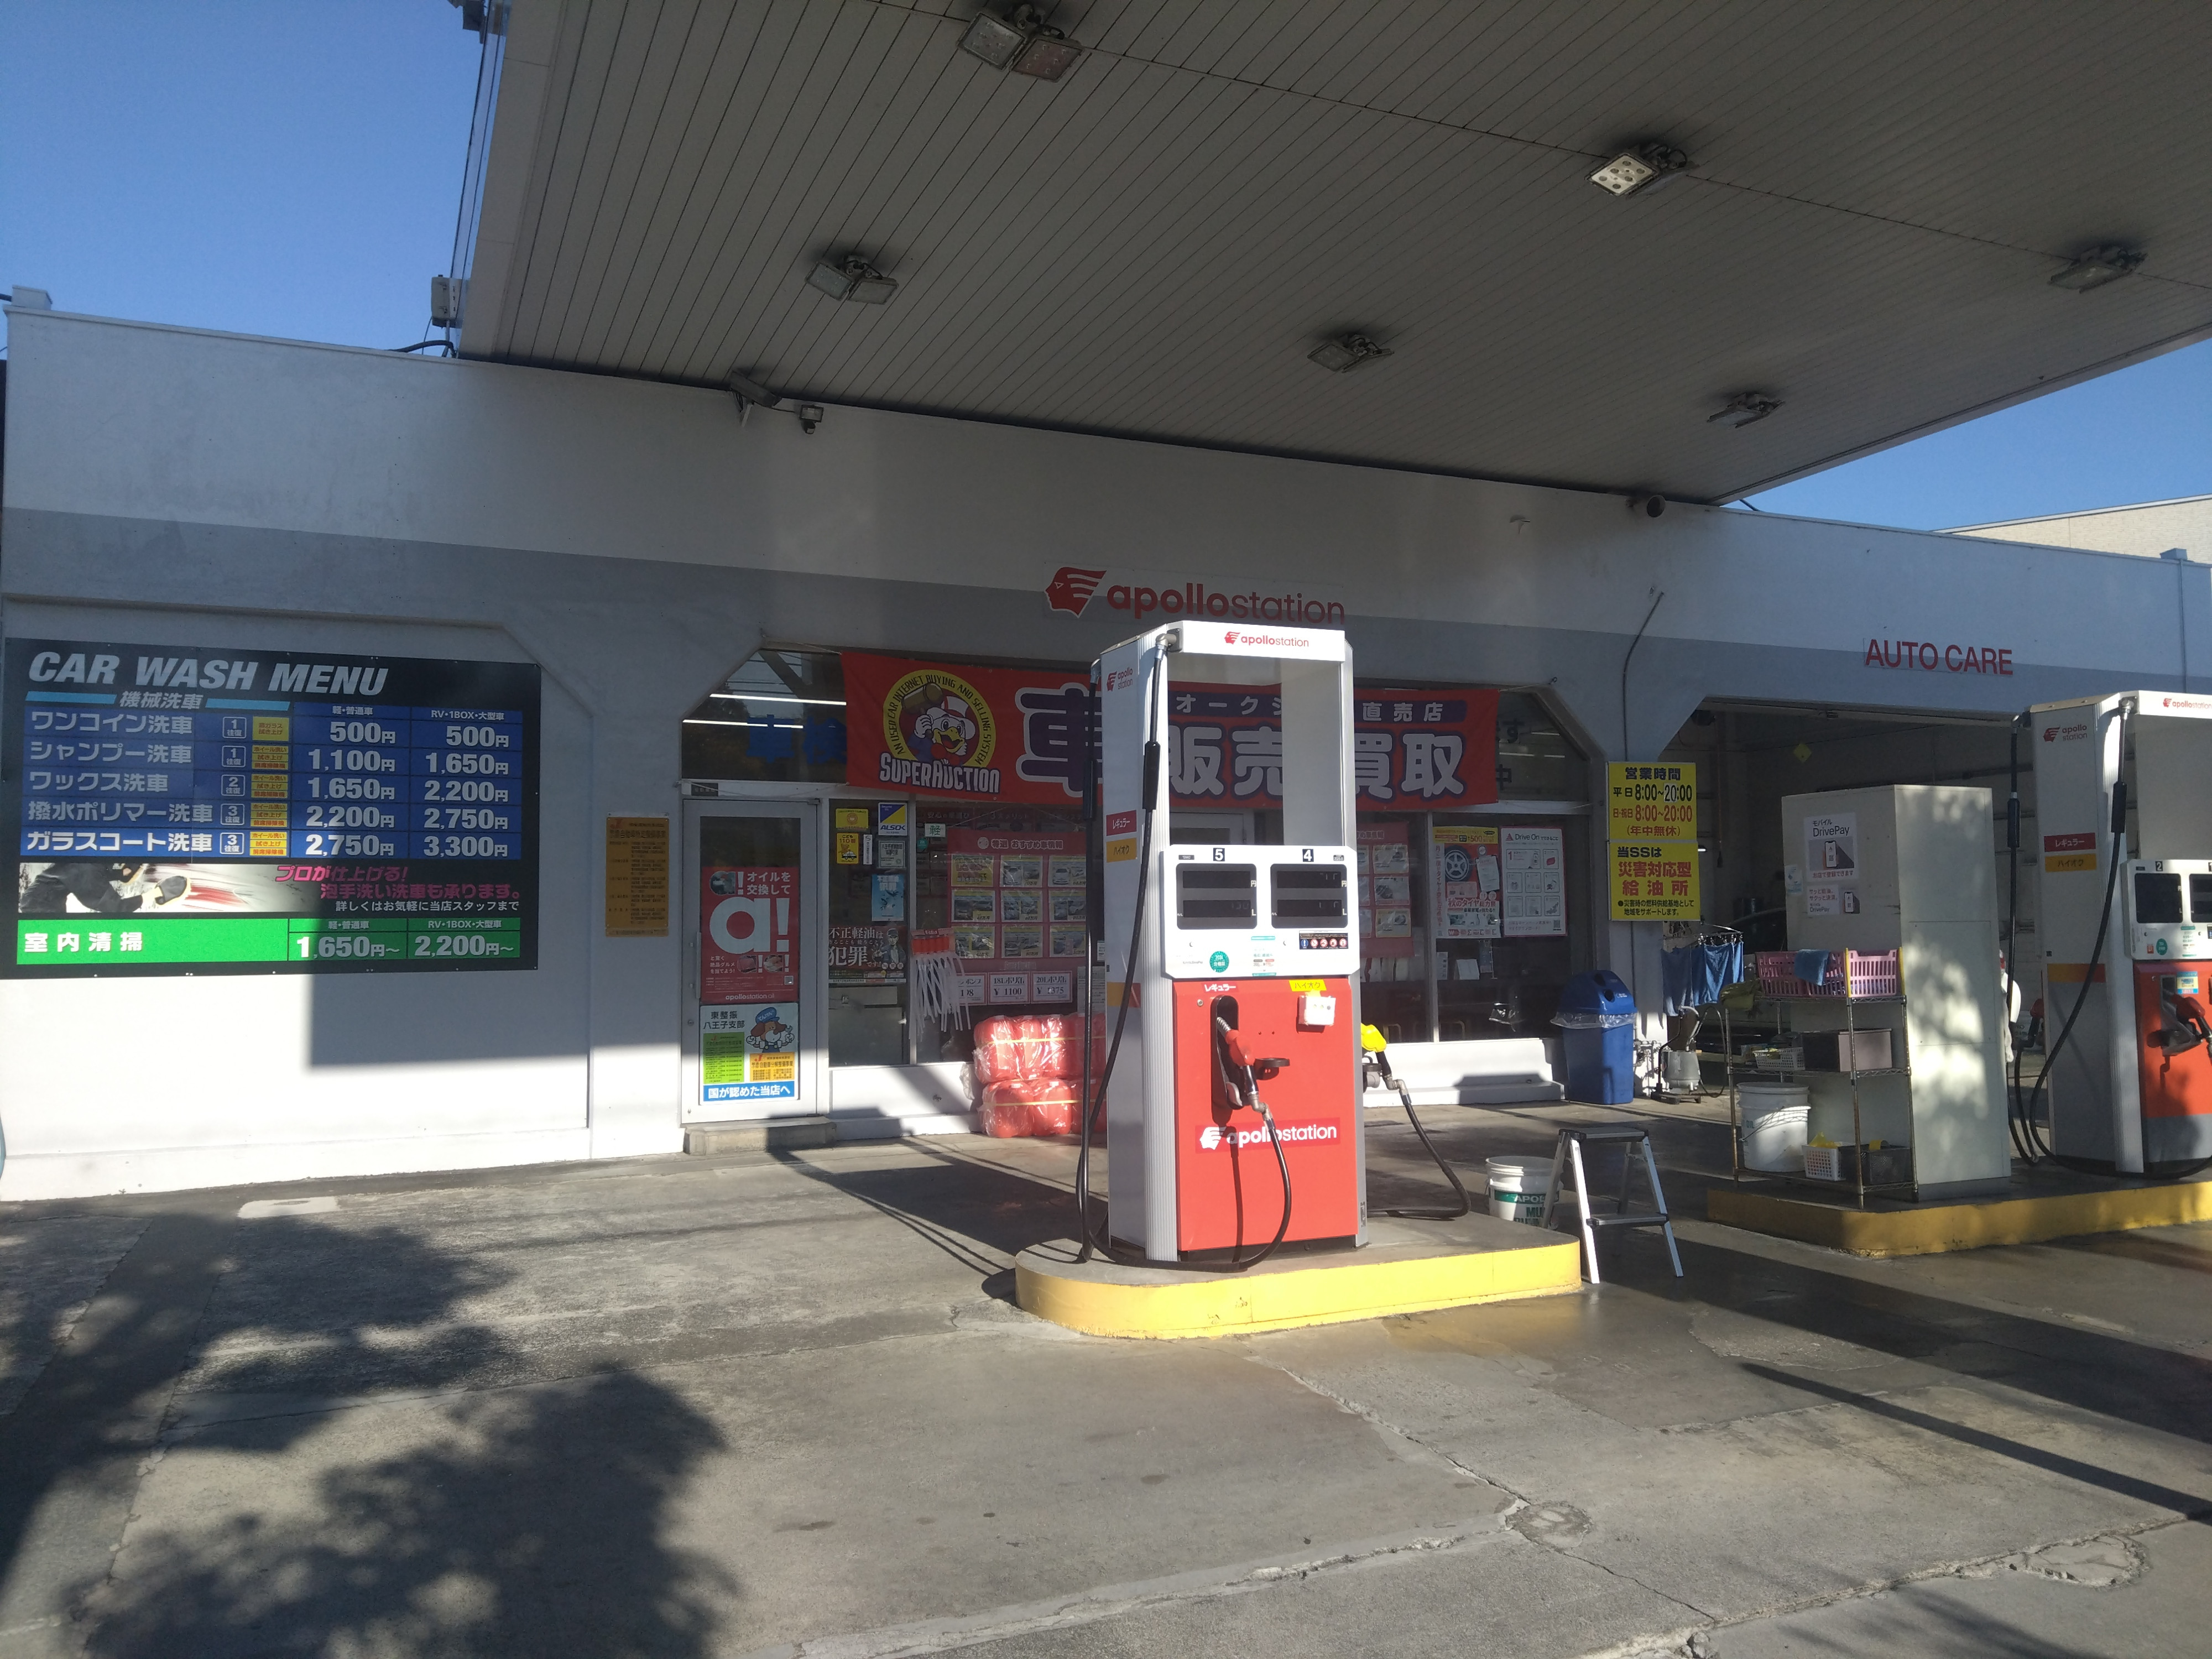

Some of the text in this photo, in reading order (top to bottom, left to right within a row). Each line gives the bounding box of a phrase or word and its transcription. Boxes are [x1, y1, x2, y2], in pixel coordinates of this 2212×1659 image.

[1107, 582, 1345, 625] apollostation
[1240, 635, 1310, 648] apollostation
[1865, 639, 2013, 676] AUTO CARE
[28, 651, 389, 696] CAR WASH MENU
[1117, 667, 1133, 680] apollo
[1118, 678, 1133, 690] station
[119, 691, 204, 710] 機械洗車
[2172, 700, 2212, 709] apollostation
[1362, 702, 1443, 722] 直売店
[32, 711, 192, 734] ワンコイン洗車
[231, 719, 237, 729] 1
[888, 674, 992, 765] AN USED CAR INTERNET BUYING AND SELLING SYSTEM
[329, 722, 396, 745] 500円
[2062, 724, 2088, 736] apollo
[445, 726, 509, 749] 500円
[2062, 731, 2089, 742] station
[31, 743, 192, 765] シャンプー洗車
[231, 748, 237, 758] 1
[308, 749, 395, 773] 1,100円
[425, 752, 509, 775] 1,650円
[1625, 767, 1681, 780] 営業時間
[28, 772, 168, 794] ワックス洗車
[228, 776, 238, 787] 2
[308, 778, 395, 801] 1,650円
[424, 780, 509, 804] 2,200円
[1613, 787, 1633, 797] 平日
[28, 801, 213, 824] 撥水ポリマー洗車
[228, 805, 238, 816] 3
[1613, 808, 1633, 818] 日・祝日
[306, 806, 395, 829] 2,200円
[424, 809, 508, 832] 2,750円
[1113, 818, 1130, 830] レギュラー
[929, 825, 941, 836] 軽
[1627, 825, 1681, 837] (年中無休)
[1813, 825, 1850, 837] DrivePay
[27, 831, 213, 853] ガラスコート洗車
[227, 834, 237, 846] 3
[305, 834, 395, 858] 2,750円
[2055, 838, 2085, 848] レギュラー
[424, 836, 508, 858] 3,300円
[1114, 844, 1130, 855] ハイオク
[1618, 847, 1662, 858] 当SSは
[1214, 849, 1224, 860] 5
[1303, 850, 1312, 862] 4
[1618, 861, 1692, 878] 災害対応型
[2156, 862, 2163, 872] 2
[747, 872, 791, 882] オイルを
[1812, 870, 1854, 878] お店で登録できます
[320, 883, 520, 900] 泡手洗い洗車も承ります。
[747, 884, 791, 895] 交換して
[1622, 880, 1688, 896] 給油所
[336, 900, 520, 912] 詳しくはお気軽に当店スタッフまで
[1624, 908, 1680, 916] 地域をサポートします。
[829, 927, 884, 939] 不正軽油は
[24, 931, 143, 953] 室内清掃
[828, 946, 868, 966] 犯罪
[1204, 983, 1237, 992] レギュラー
[1293, 981, 1321, 989] ハイオク
[711, 1010, 738, 1020] 東整振
[703, 1020, 745, 1030] 八王子支部
[708, 1085, 791, 1099] 国が認めた当店へ
[1526, 1207, 1546, 1218] MU
